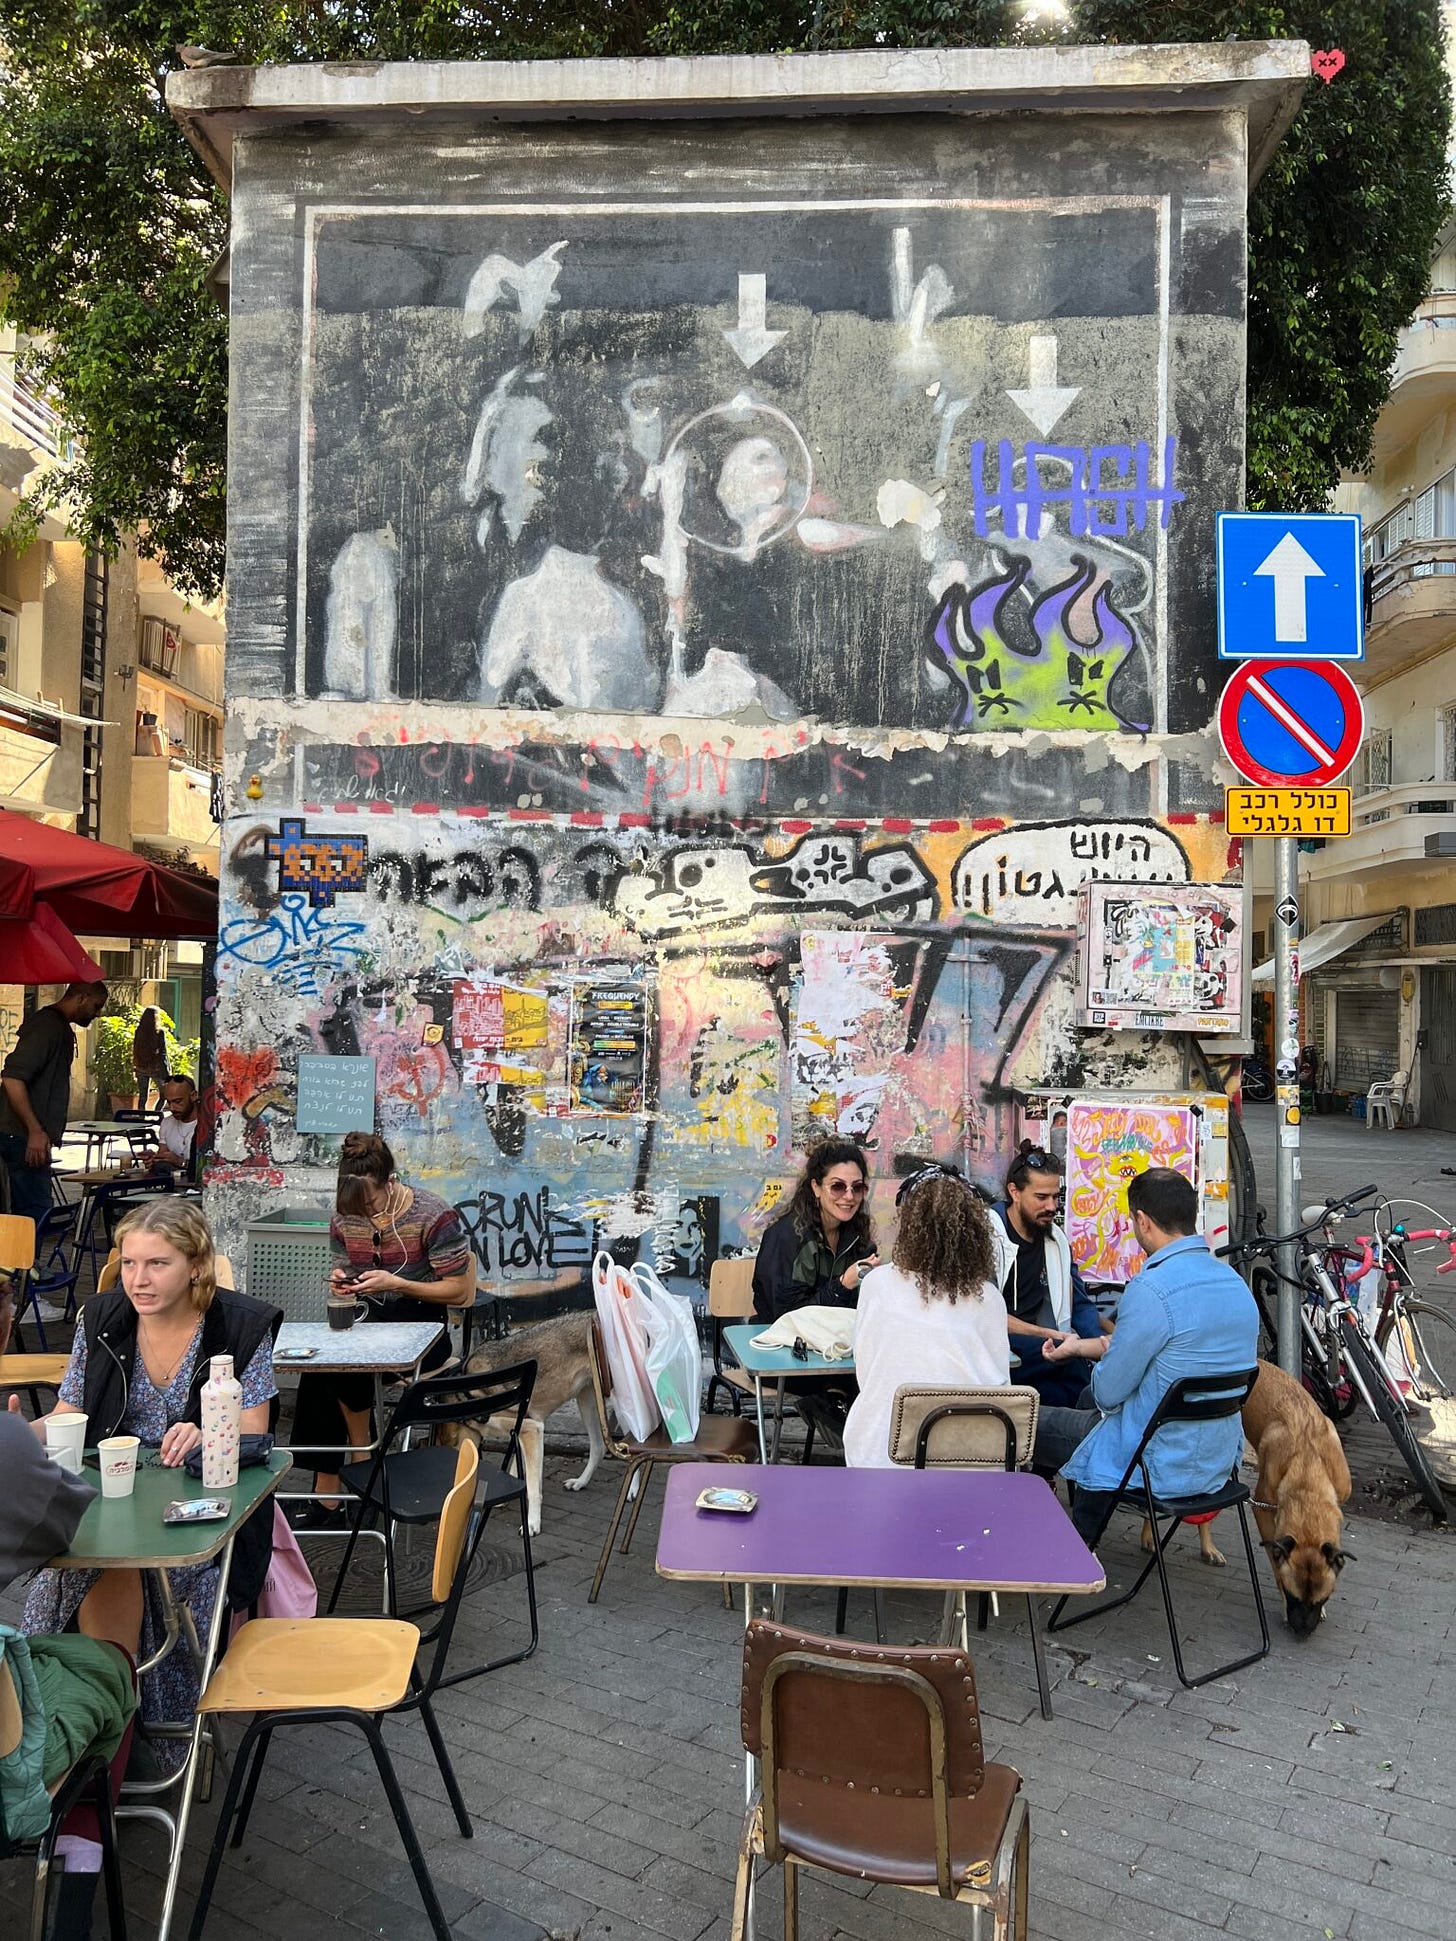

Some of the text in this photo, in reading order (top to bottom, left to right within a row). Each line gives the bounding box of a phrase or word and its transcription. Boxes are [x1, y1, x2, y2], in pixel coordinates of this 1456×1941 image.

[1240, 792, 1337, 809] כולל רכב
[1242, 814, 1335, 832] דו גלגלי
[1070, 831, 1150, 862] היוש
